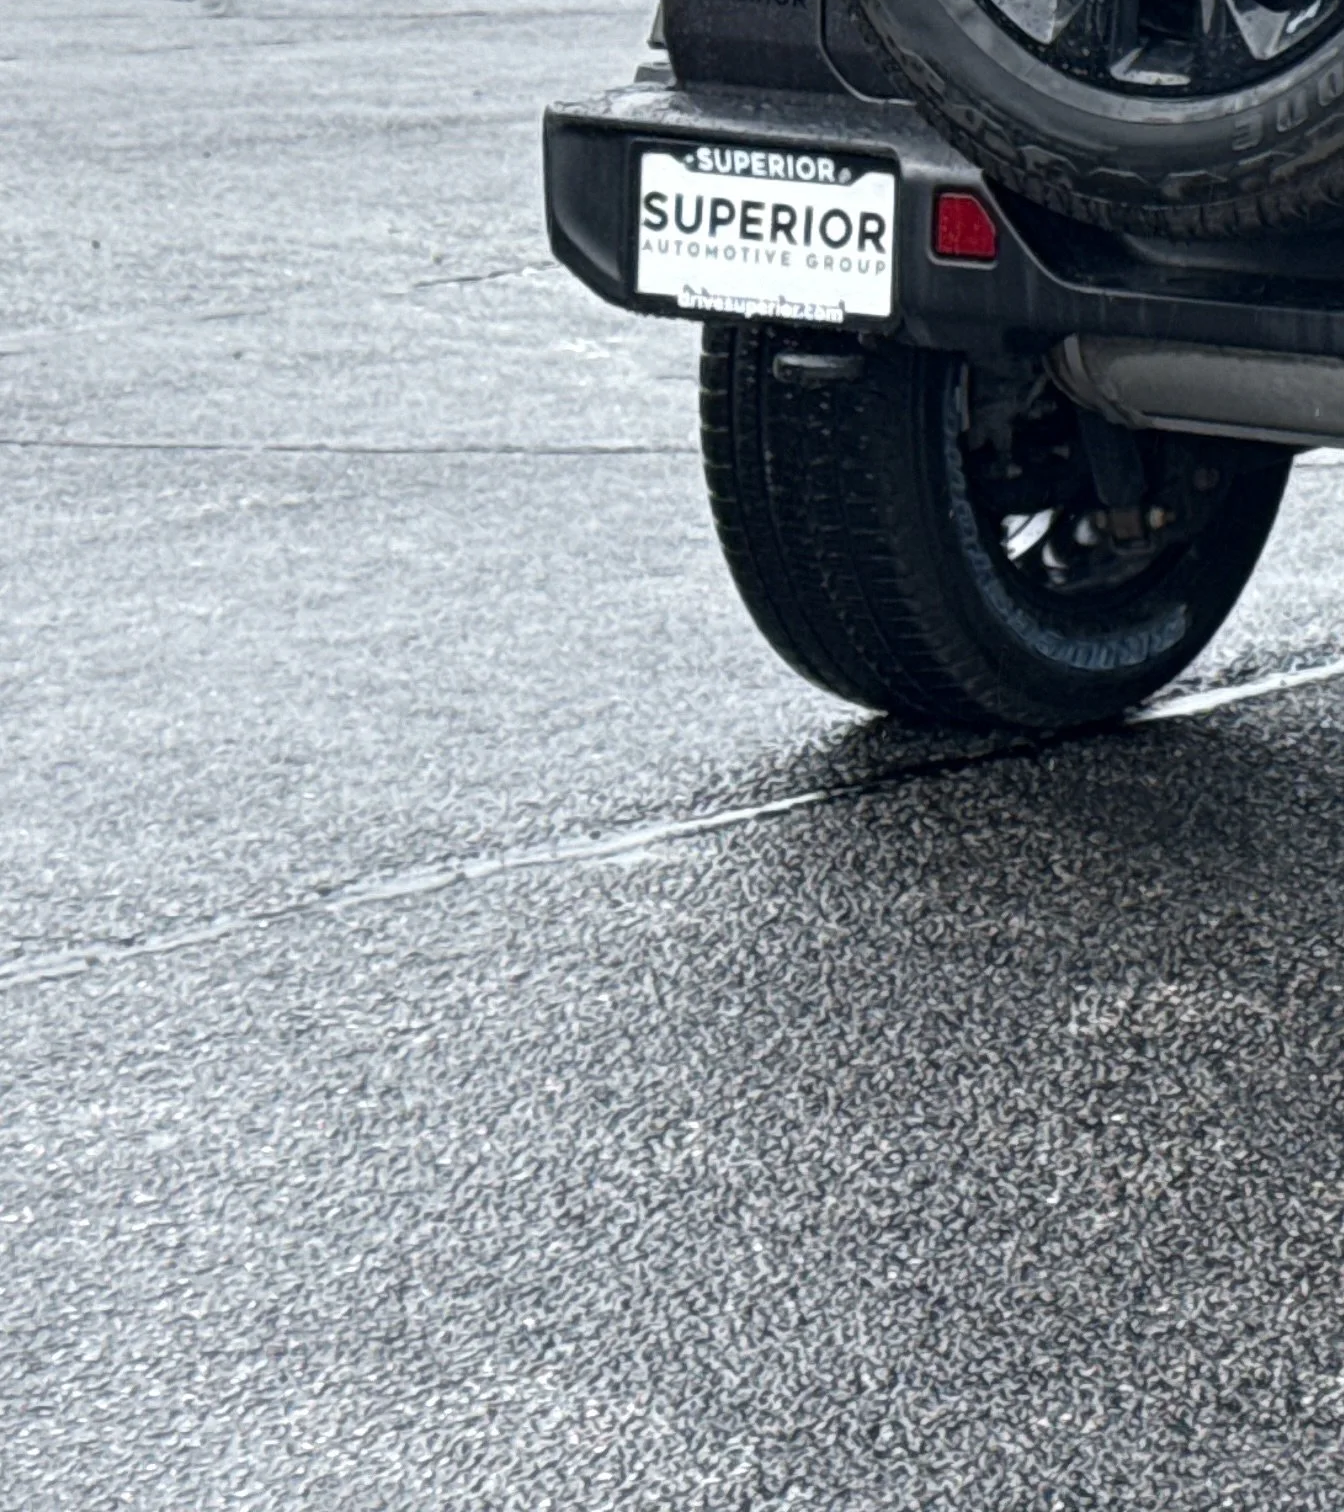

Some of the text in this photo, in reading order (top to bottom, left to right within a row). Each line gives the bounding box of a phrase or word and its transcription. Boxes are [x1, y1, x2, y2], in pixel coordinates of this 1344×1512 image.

[695, 147, 836, 183] SUPERIOR
[642, 190, 887, 255] SUPERIOR
[641, 238, 887, 276] AUTOMOTIVE GROUP
[677, 288, 844, 322] drivesuperior.com
